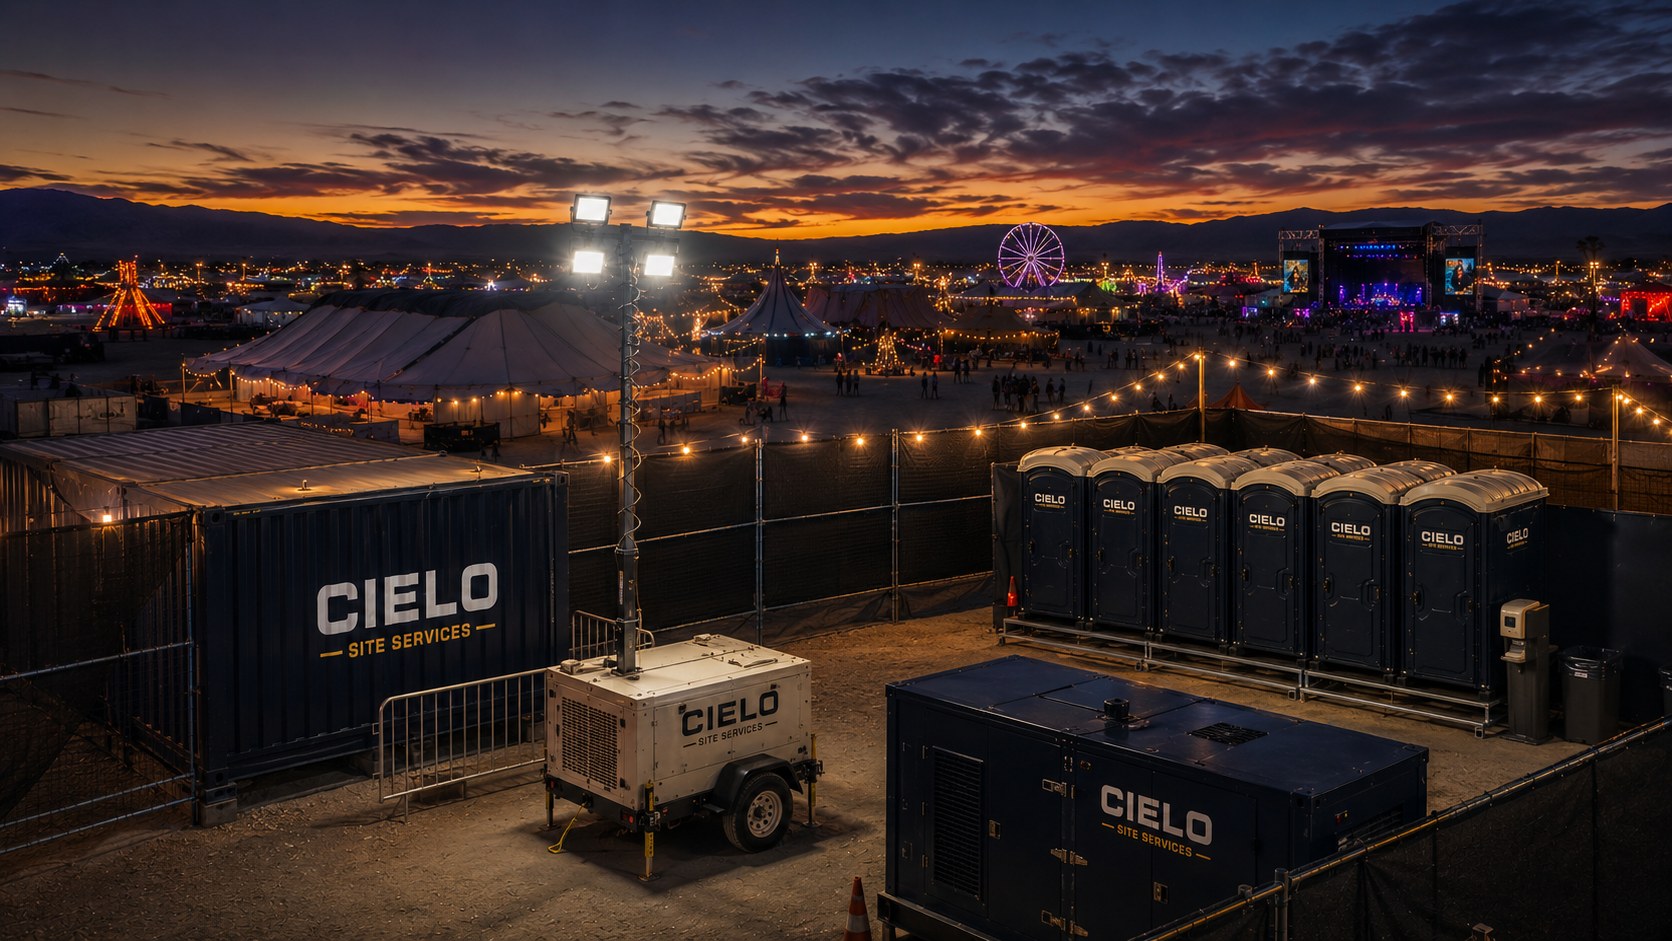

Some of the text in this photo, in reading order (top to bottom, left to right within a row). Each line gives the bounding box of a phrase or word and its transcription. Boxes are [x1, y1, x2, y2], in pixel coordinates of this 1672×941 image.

[1034, 493, 1066, 505] CIELO
[1103, 498, 1136, 511] CIELO
[1173, 505, 1208, 518] CIELO
[1249, 513, 1285, 527] CIELO
[1331, 522, 1371, 536] CIELO
[1506, 527, 1529, 544] CIELO
[1421, 531, 1464, 545] CIELO
[316, 562, 498, 636] CIELO
[348, 622, 471, 659] SITE SERVICES
[681, 690, 779, 737] CIELO
[698, 722, 763, 746] SITE SERVICES
[1101, 784, 1213, 846] CIELO
[1116, 824, 1193, 857] SITE SERVICES
